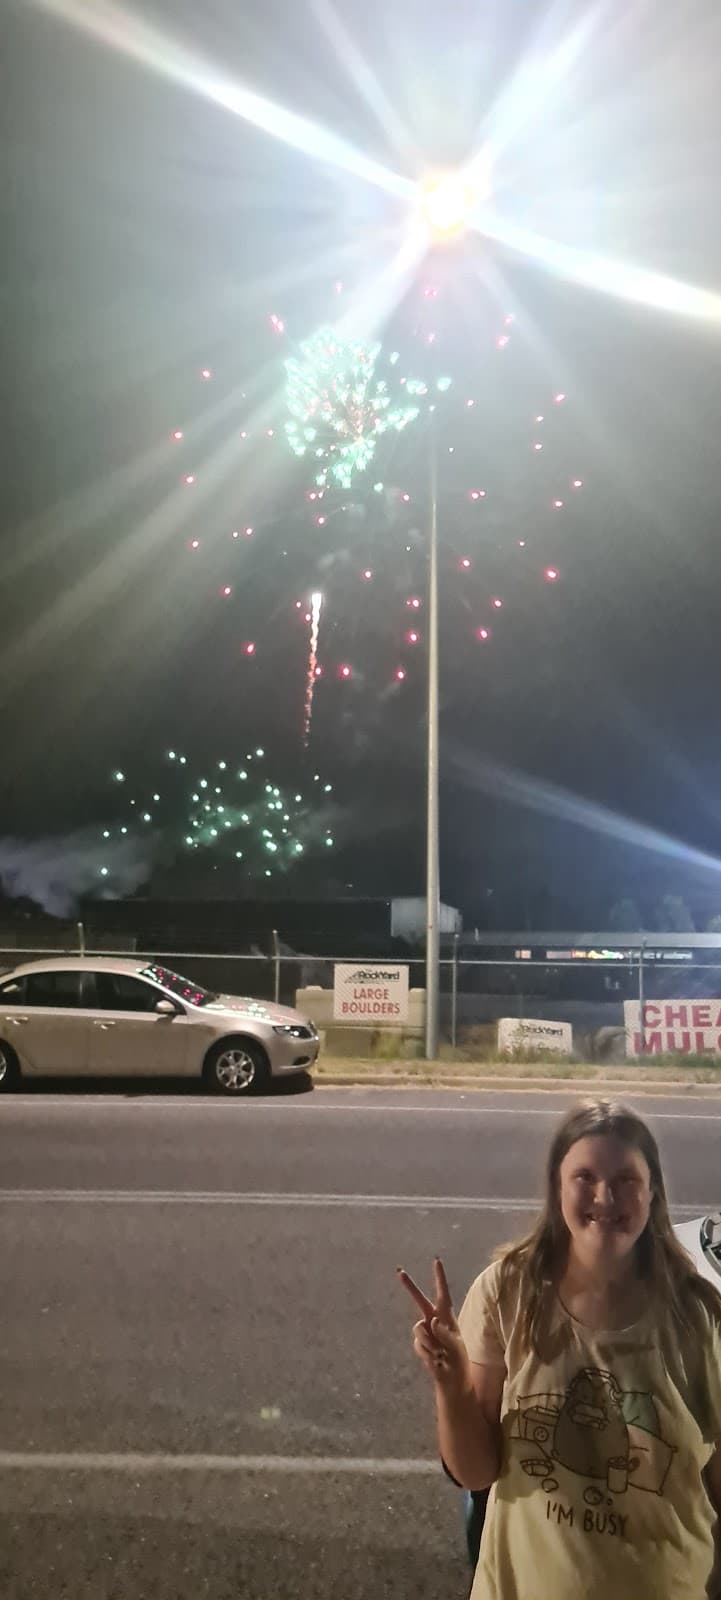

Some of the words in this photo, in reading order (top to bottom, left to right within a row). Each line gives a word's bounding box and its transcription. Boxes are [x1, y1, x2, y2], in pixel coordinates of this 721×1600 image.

[353, 988, 389, 1000] LARGE
[341, 1002, 401, 1014] BOULDERS
[633, 1031, 721, 1055] MUL
[546, 1500, 575, 1527] I'M
[583, 1509, 630, 1536] BUSY
